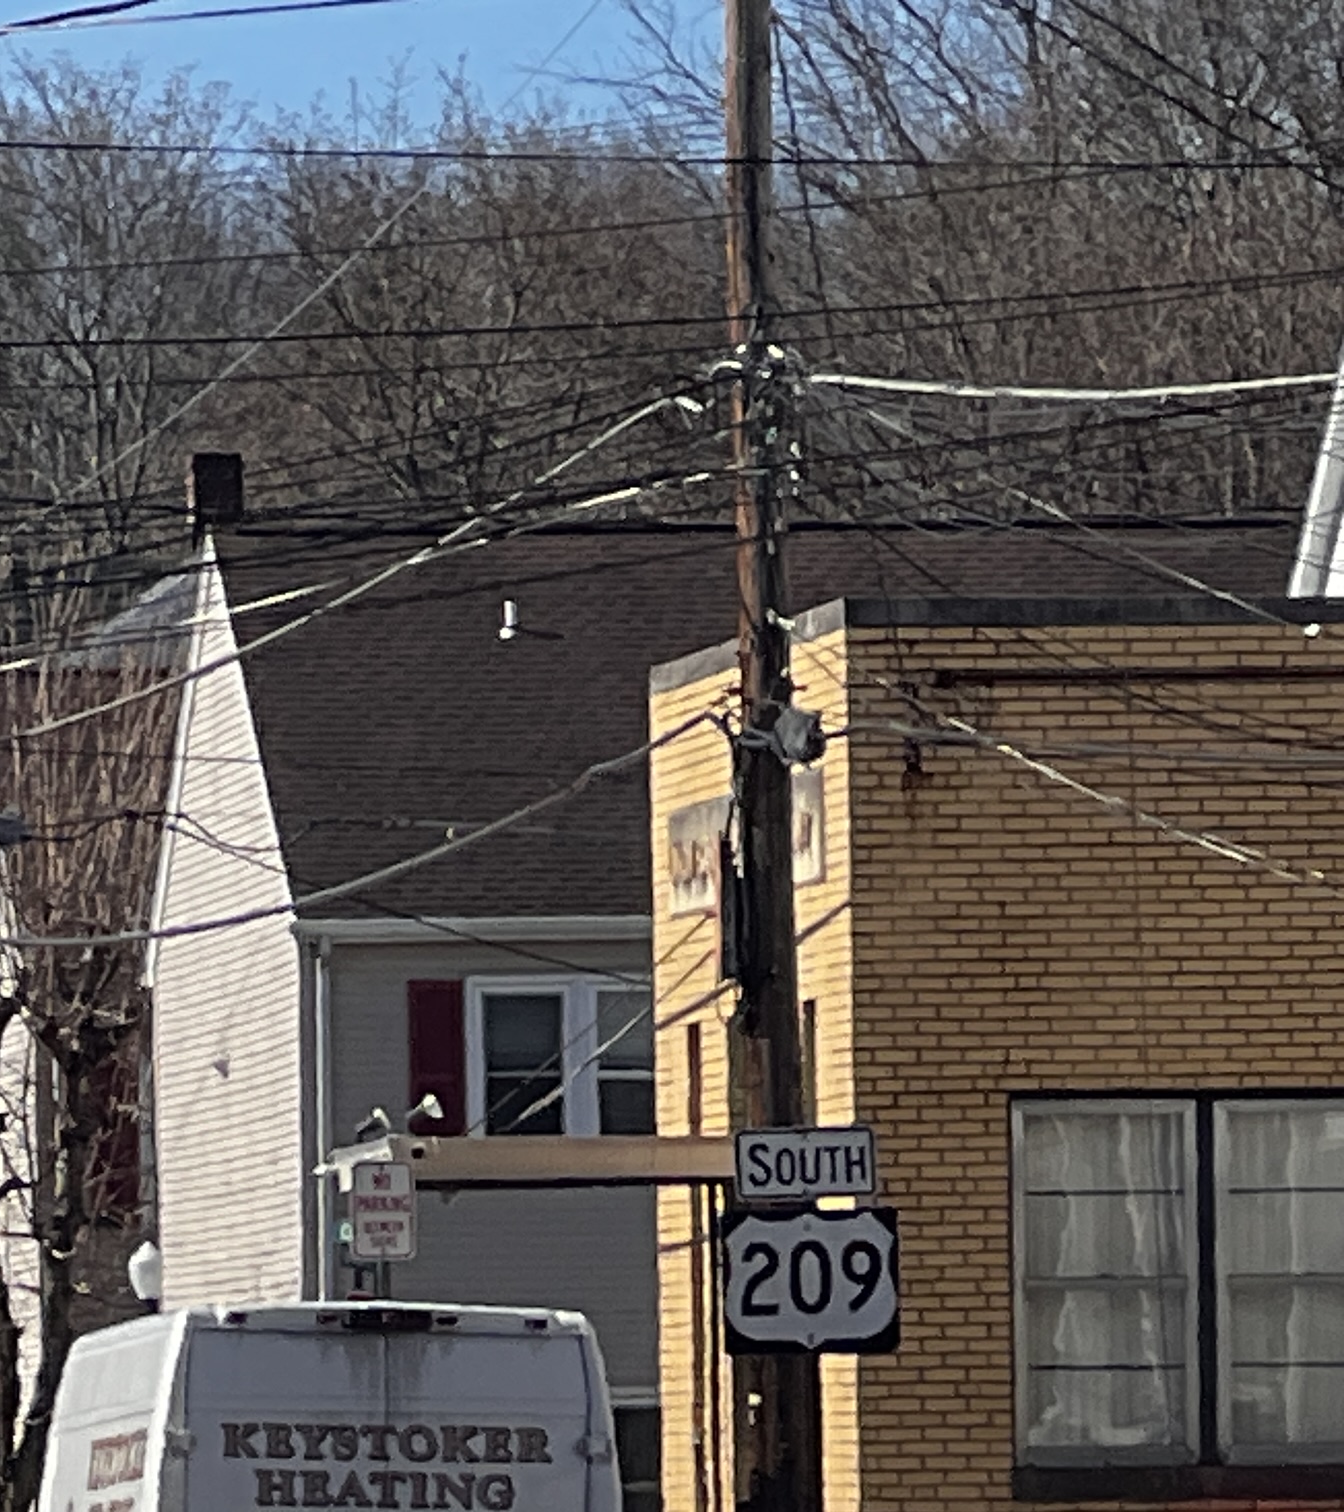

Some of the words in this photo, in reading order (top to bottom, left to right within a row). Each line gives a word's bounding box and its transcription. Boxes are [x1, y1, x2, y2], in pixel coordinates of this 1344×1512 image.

[747, 1143, 867, 1187] SOUTH
[740, 1239, 883, 1317] 209
[220, 1422, 554, 1464] KEYSTOKER
[253, 1468, 517, 1511] HEATING
